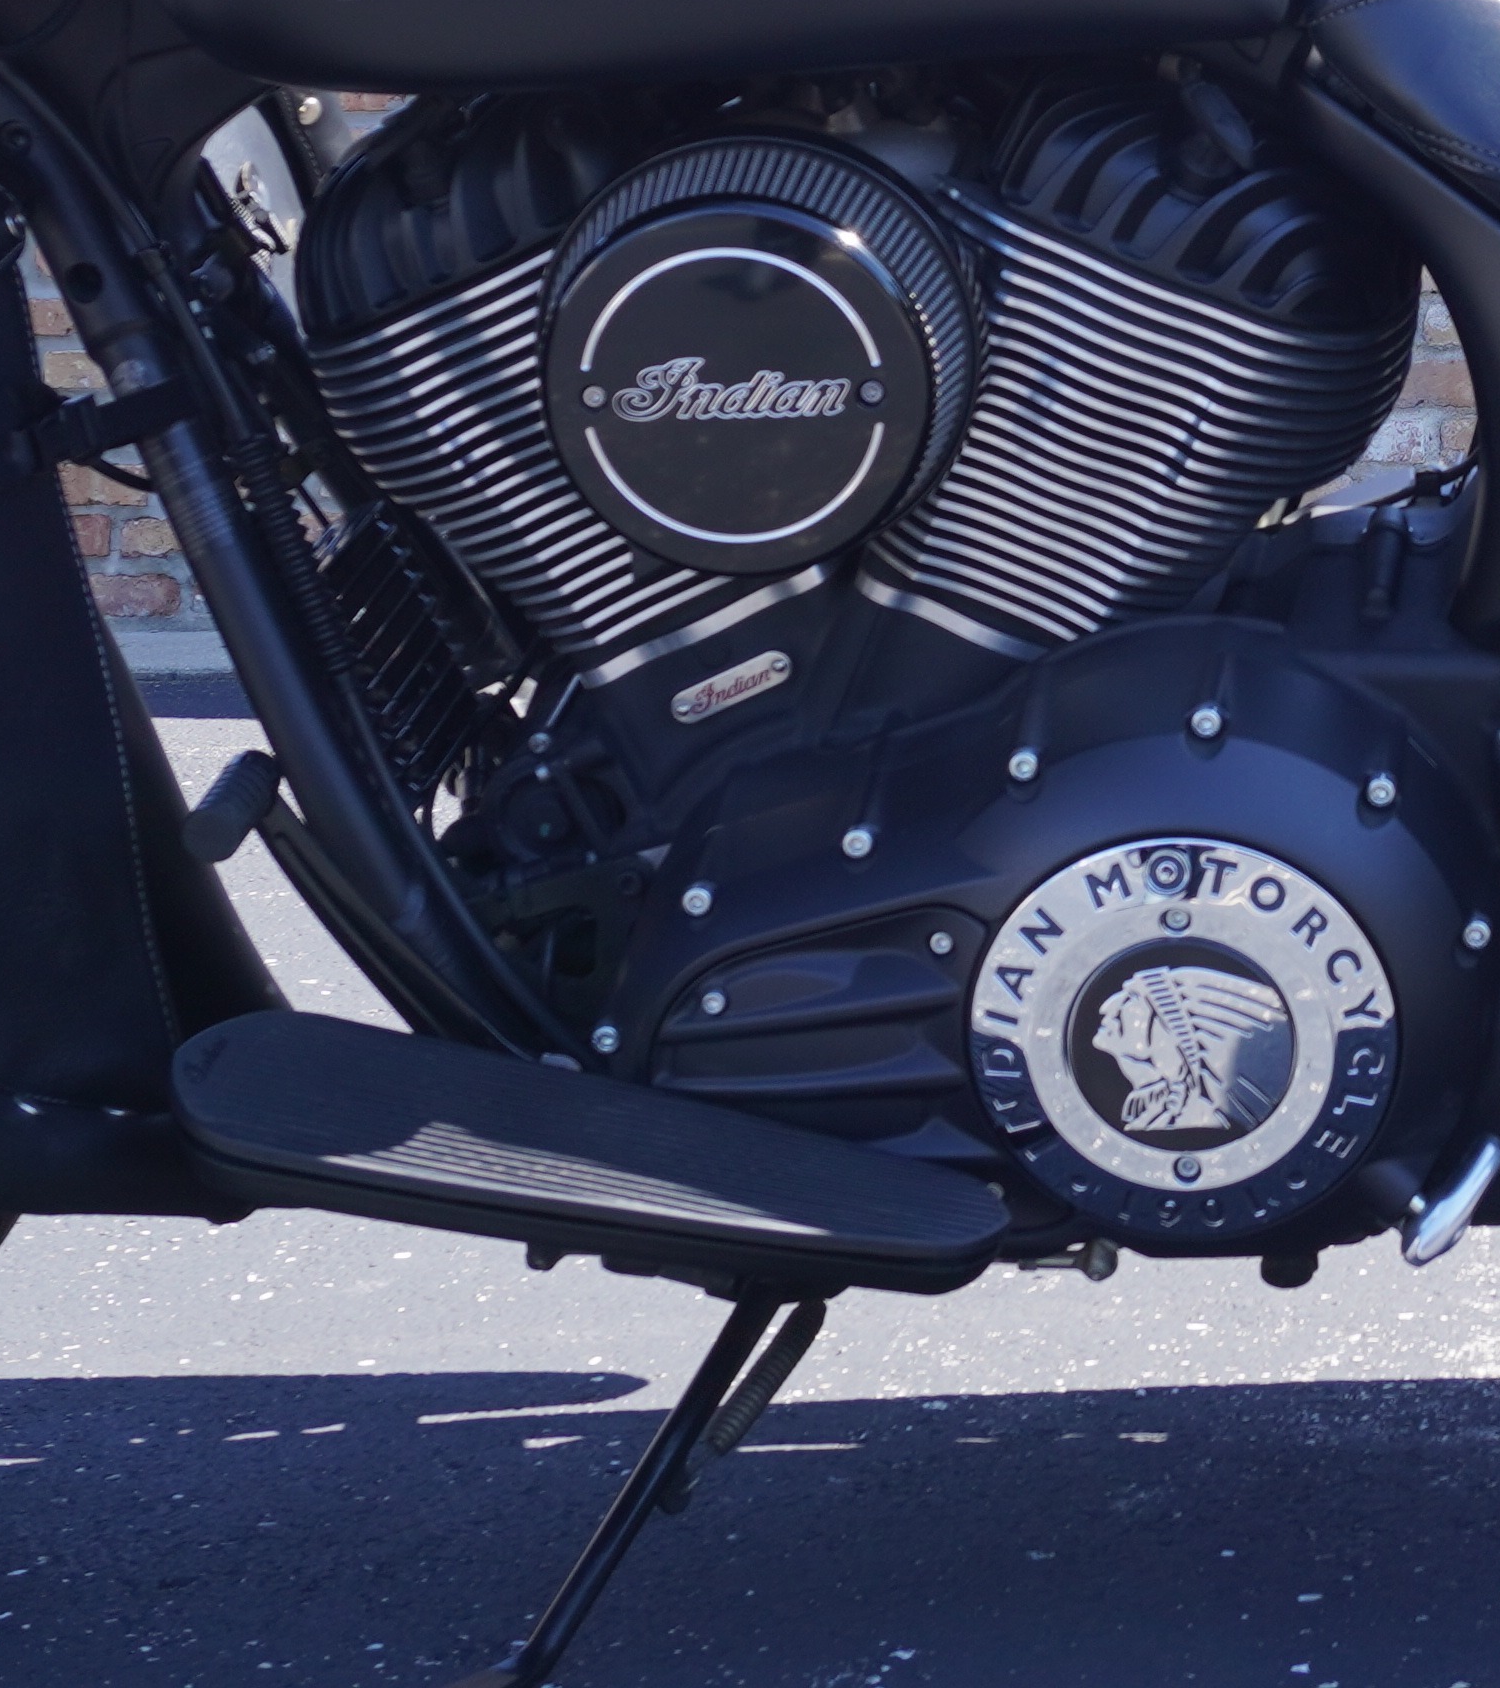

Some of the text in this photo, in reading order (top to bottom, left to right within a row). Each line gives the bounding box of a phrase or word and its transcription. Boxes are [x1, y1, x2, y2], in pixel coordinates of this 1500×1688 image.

[611, 356, 852, 423] Indian
[687, 668, 772, 715] Indian
[1083, 851, 1385, 1160] MOTORCYCLE
